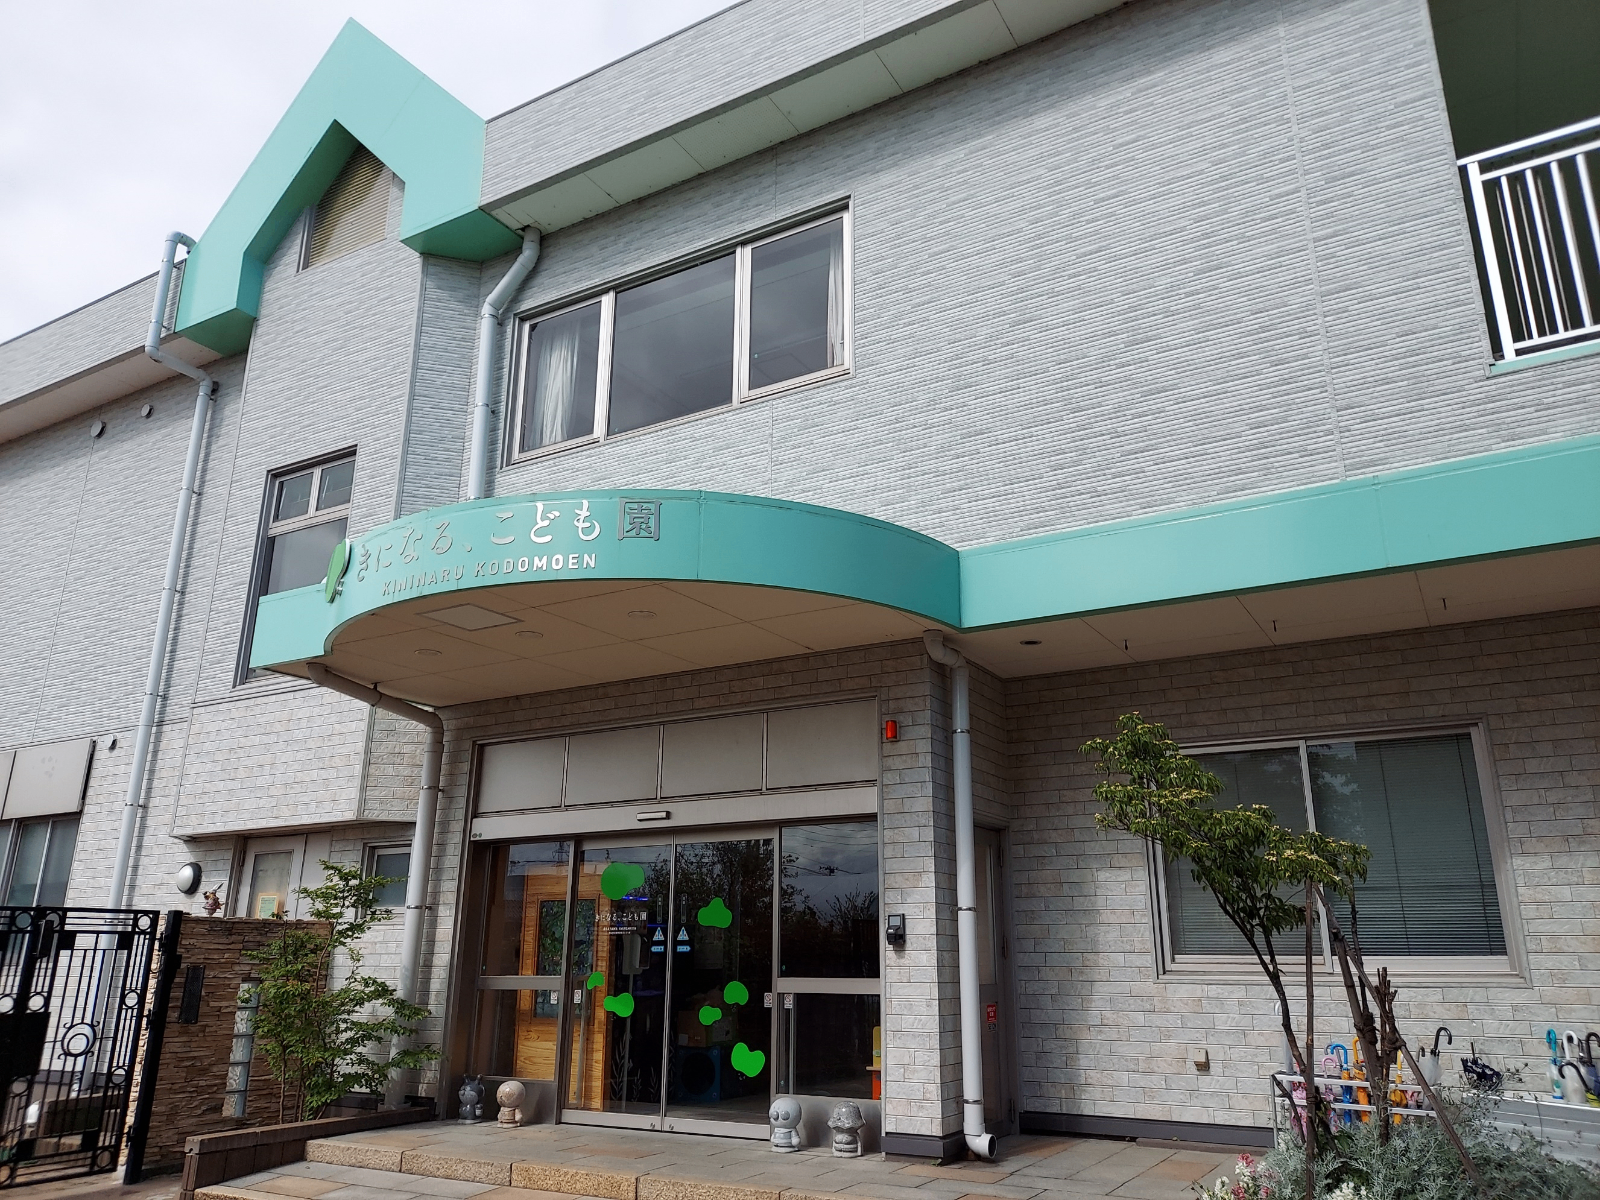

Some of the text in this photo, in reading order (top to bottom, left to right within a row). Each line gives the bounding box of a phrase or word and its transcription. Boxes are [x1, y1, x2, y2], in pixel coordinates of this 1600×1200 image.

[357, 500, 662, 582] きになる、こども園
[382, 553, 597, 597] KININARU KODOMOEN
